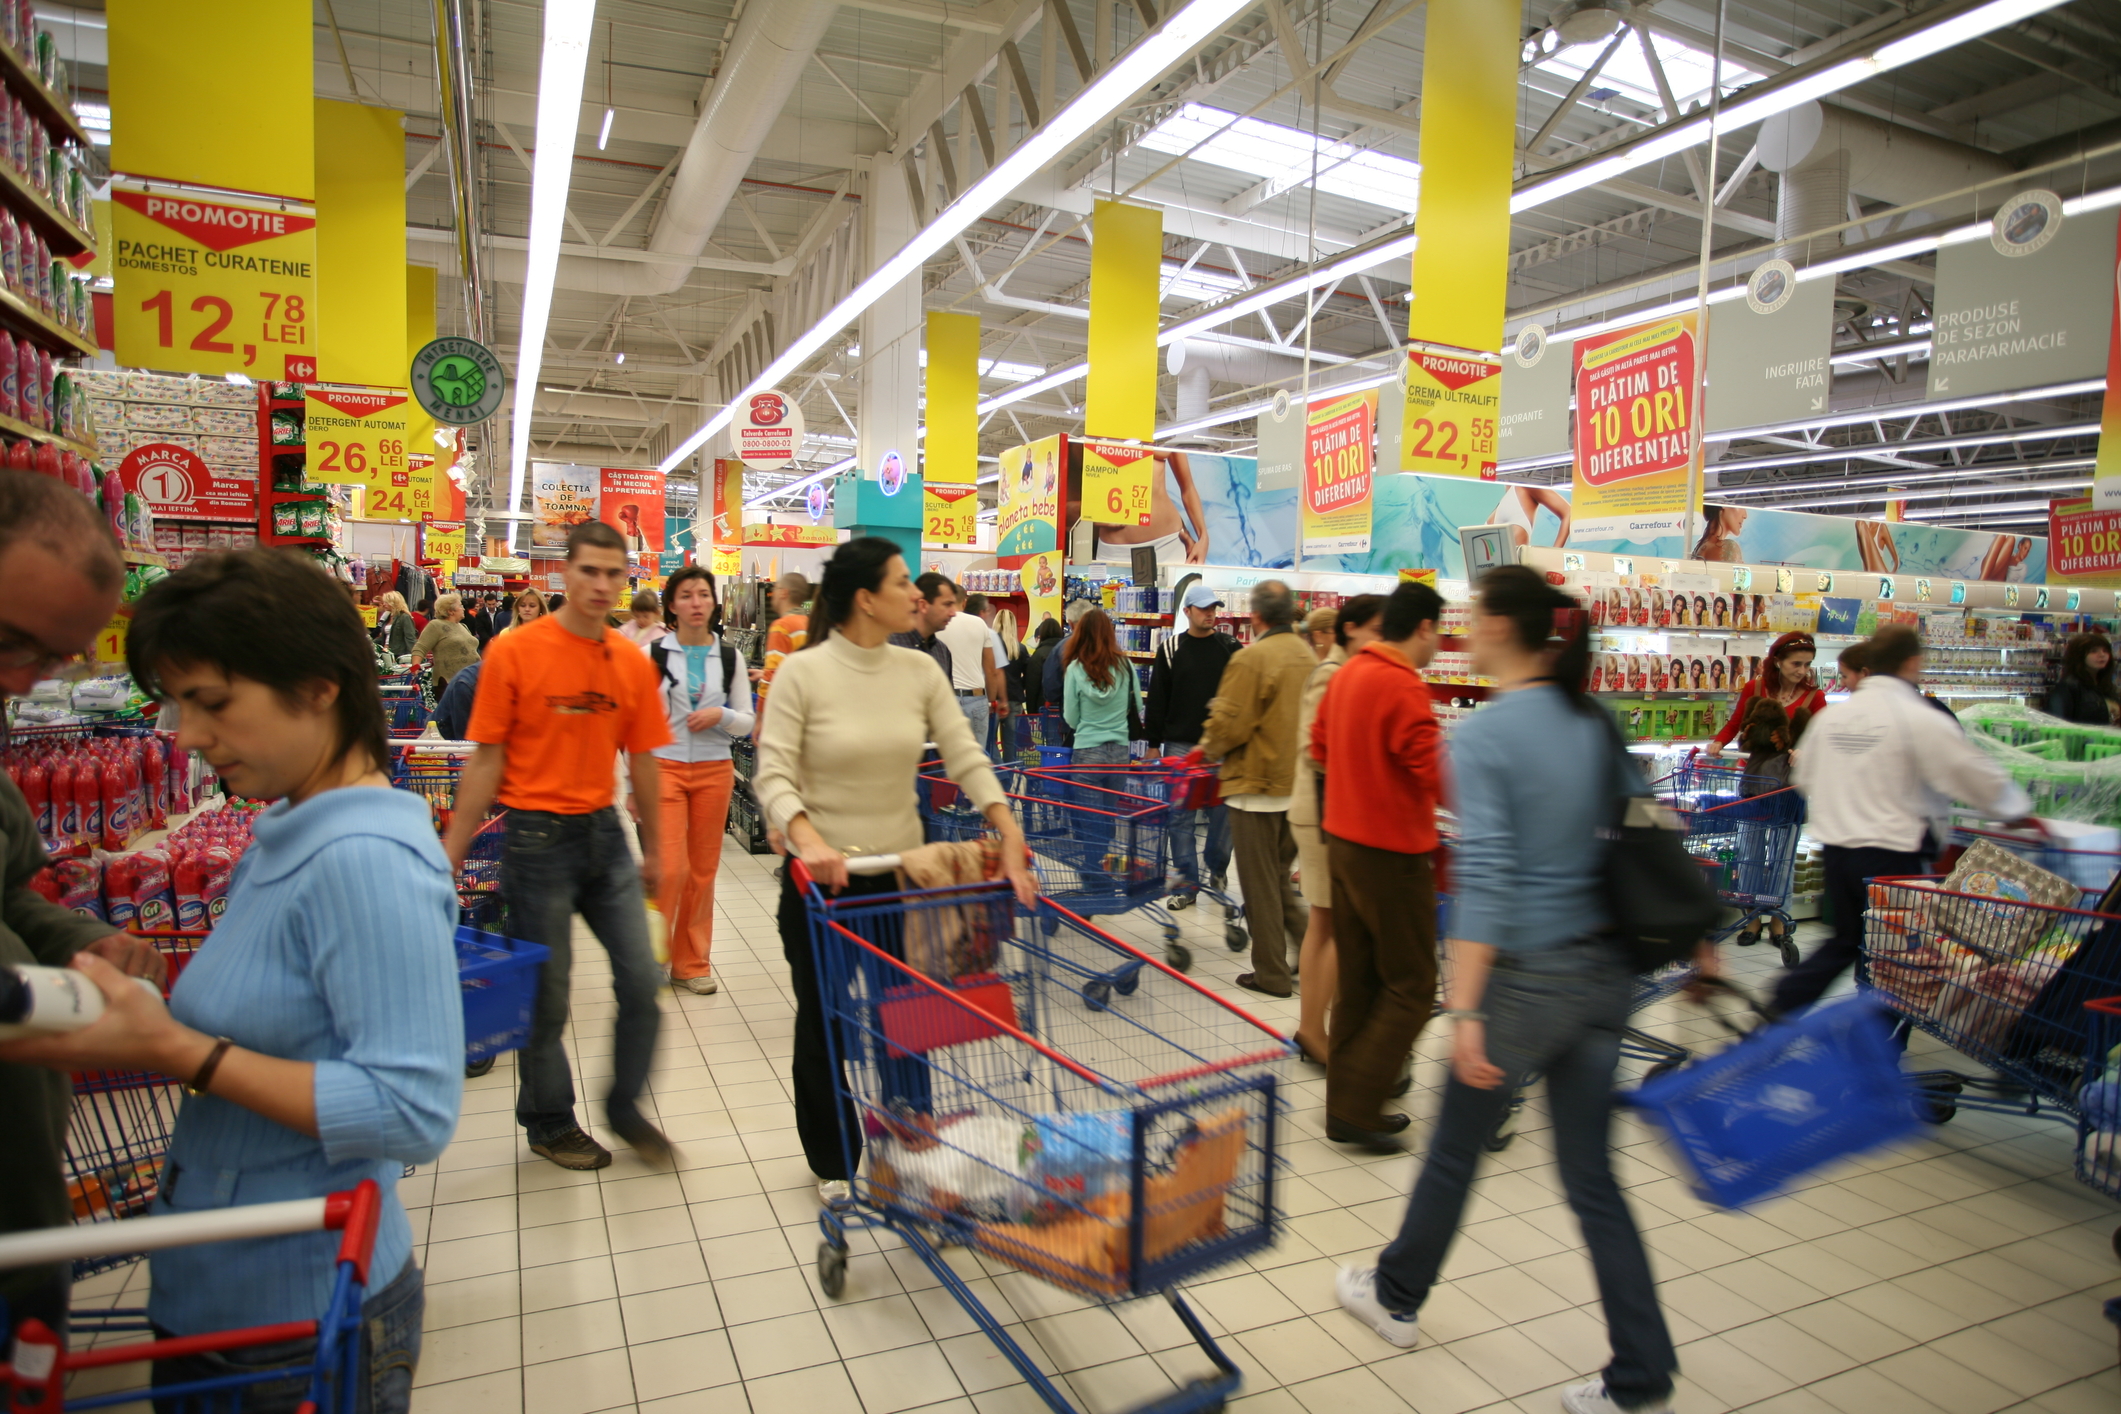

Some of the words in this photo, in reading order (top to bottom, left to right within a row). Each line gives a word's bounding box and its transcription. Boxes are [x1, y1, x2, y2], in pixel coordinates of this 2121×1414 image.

[118, 240, 199, 264] PACHET
[204, 251, 312, 278] CURATENIE
[118, 257, 199, 276] DOMESTOS
[259, 291, 306, 323] 78
[1938, 300, 2020, 329] PRODUSE
[262, 322, 306, 345] LEI
[1937, 330, 1958, 346] DE
[1962, 318, 2021, 342] SEZON
[1936, 330, 2068, 366] PARAFARMACIE
[1765, 357, 1825, 380] INGRIJIRE
[1590, 372, 1650, 410] PLĂTIM
[1657, 361, 1679, 389] DE
[1795, 374, 1824, 390] FATA
[1407, 396, 1436, 407] GARNIER
[1408, 384, 1442, 400] CREMA
[1444, 390, 1498, 407] ULTRALIFT
[308, 416, 362, 428] DETERGENT
[364, 420, 406, 431] AUTOMAT
[1589, 405, 1621, 450] 10
[1630, 385, 1686, 439] ORI
[273, 428, 293, 436] ARIEL
[764, 429, 787, 437] Carrefour
[1470, 417, 1494, 439] 55
[379, 438, 403, 455] 66
[742, 439, 791, 448] 0800-0800-02
[1311, 430, 1347, 457] PLĂTIM
[1350, 423, 1361, 444] DE
[1471, 438, 1493, 454] LEI
[136, 450, 190, 469] MARCA
[380, 455, 403, 467] LEI
[1312, 454, 1334, 488] 10
[1337, 441, 1365, 480] ORI
[1085, 464, 1119, 475] SAMPON
[1258, 466, 1275, 476] SPUMA
[1274, 465, 1282, 473] DE
[1282, 463, 1293, 472] RAS
[212, 481, 240, 489] Marca
[1131, 484, 1149, 499] 57
[413, 488, 430, 500] 64
[168, 505, 199, 513] IEFTINA
[220, 499, 247, 507] Romania
[414, 500, 430, 509] LEI
[545, 502, 588, 512] TOAMNA
[1131, 498, 1148, 509] LEI
[276, 518, 297, 527] ARIEL
[302, 520, 322, 529] ARIEL
[961, 515, 975, 526] 19
[998, 505, 1029, 541] planeta
[1032, 496, 1056, 517] bebe
[1629, 520, 1672, 530] Carrefour
[961, 525, 975, 533] LEI
[2061, 520, 2104, 537] PLĂTIM
[2060, 535, 2085, 558] 10
[142, 902, 161, 917] Cif
[211, 900, 227, 915] Cif
